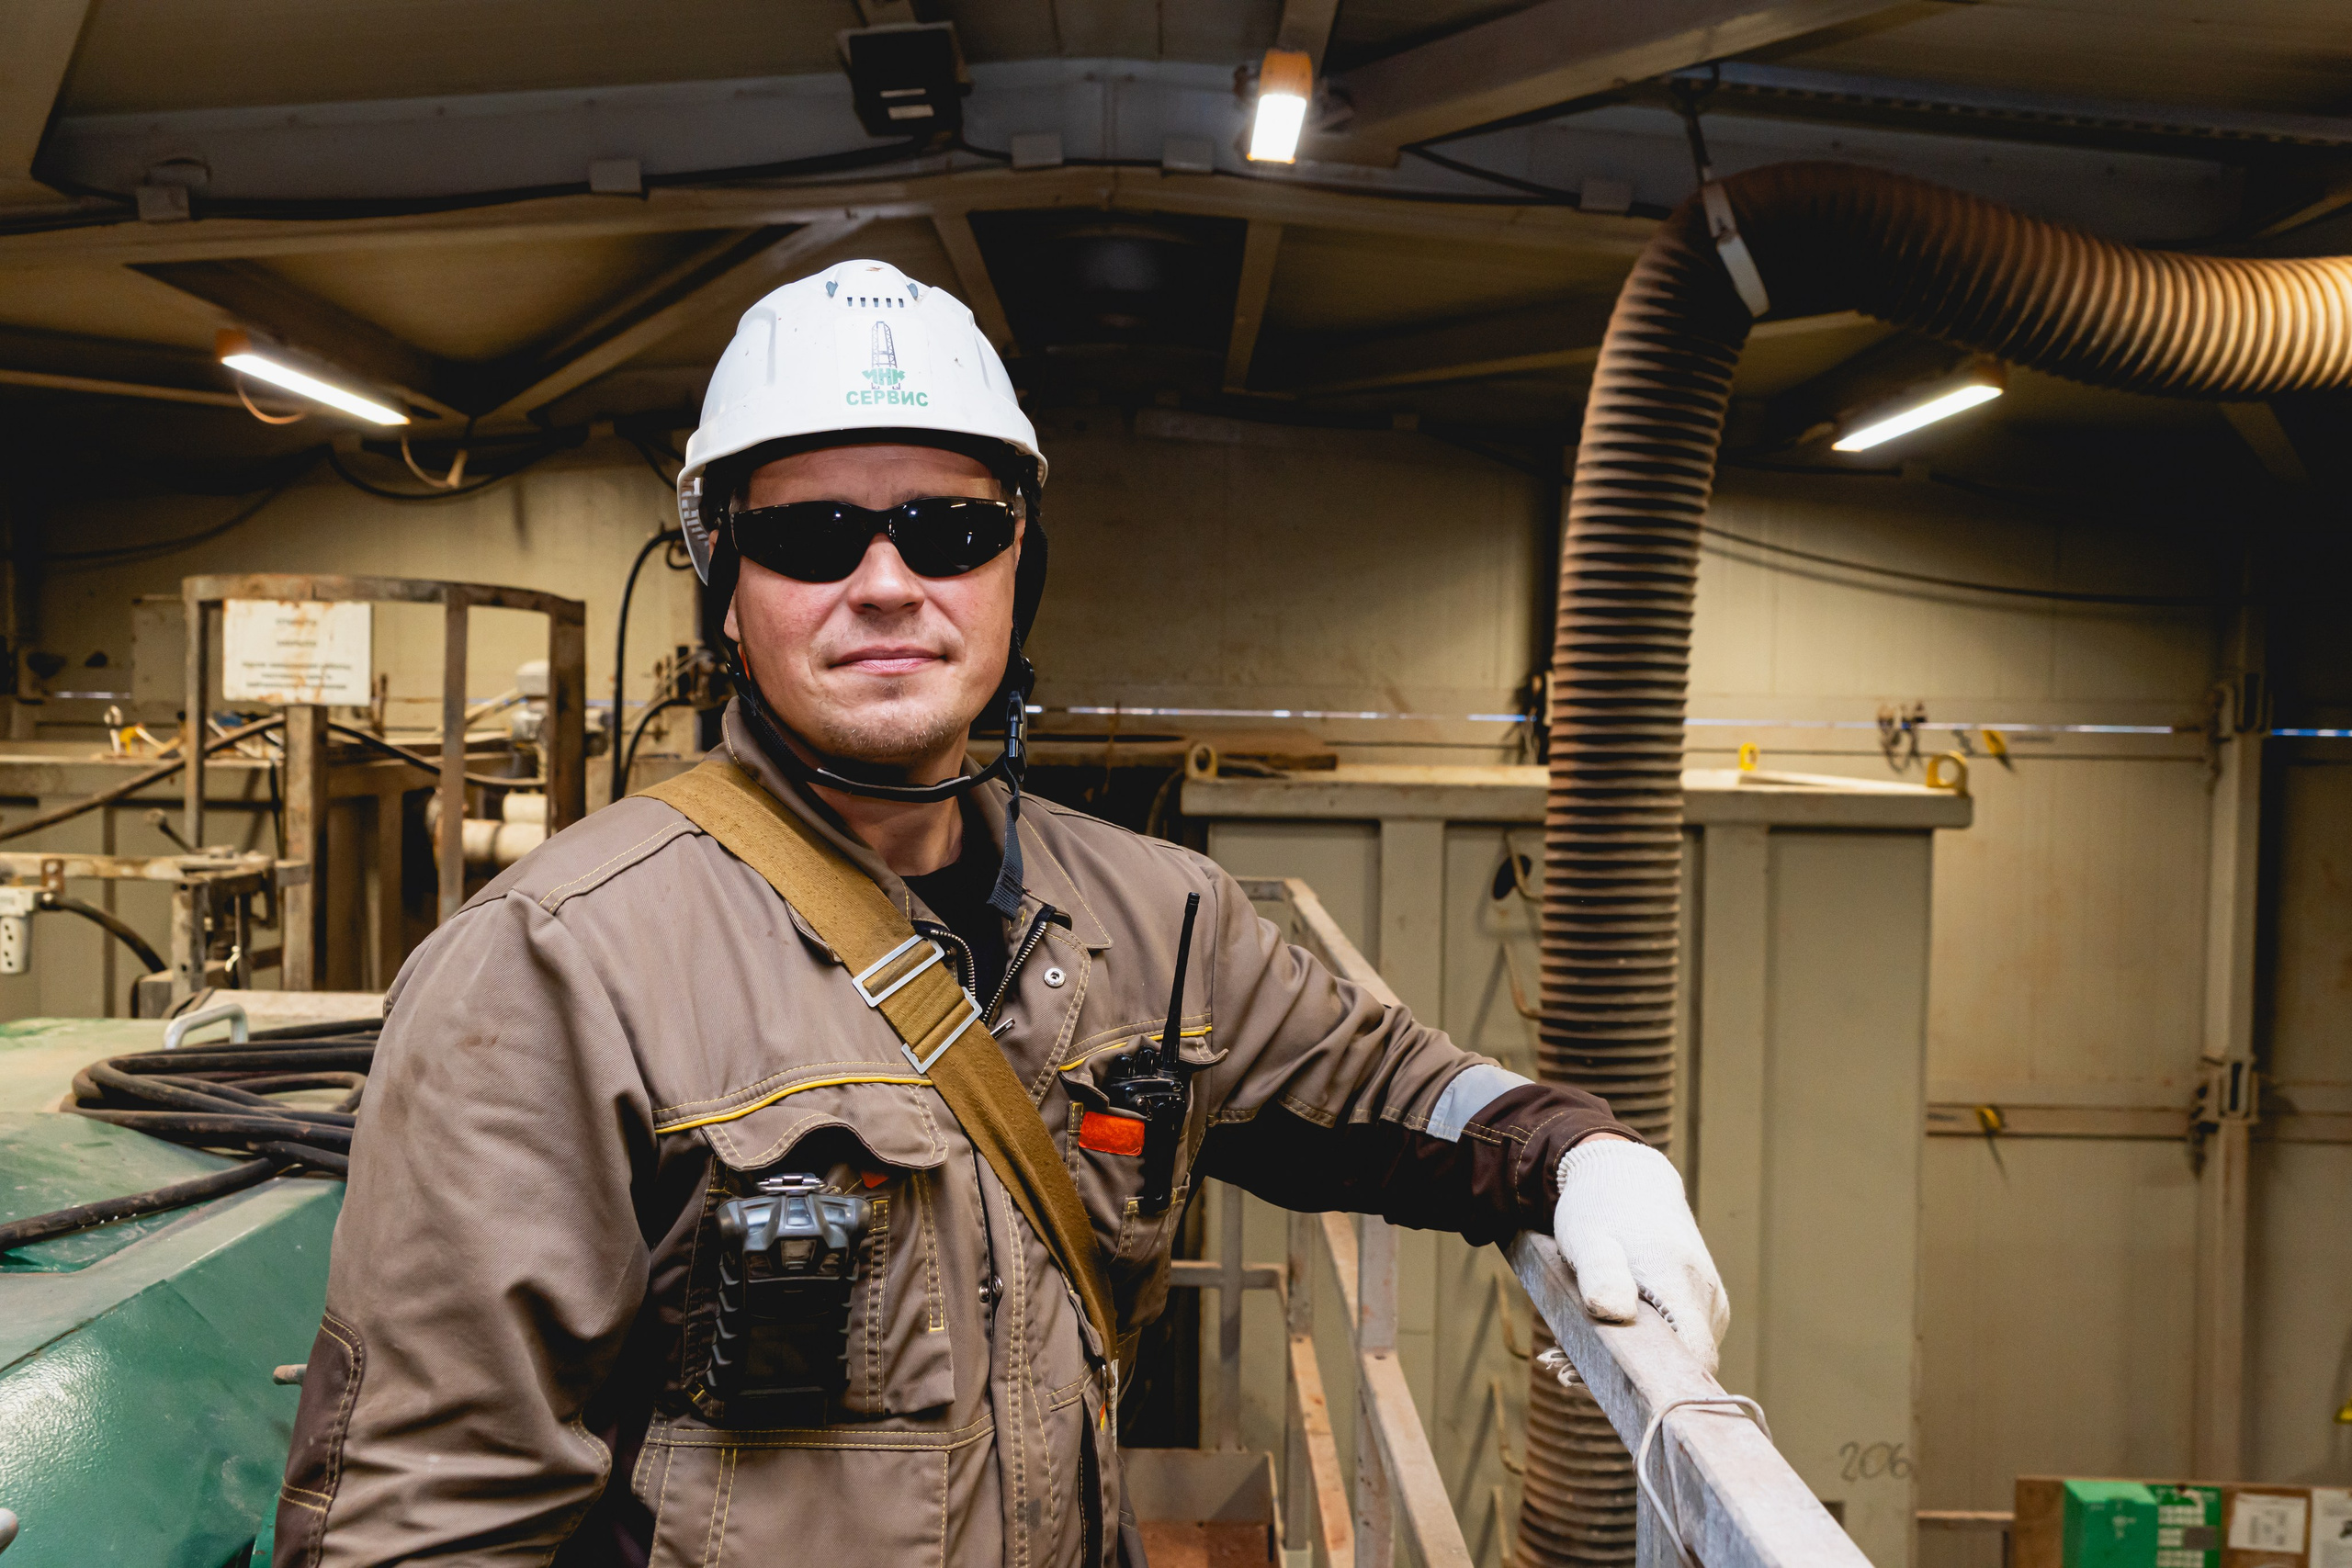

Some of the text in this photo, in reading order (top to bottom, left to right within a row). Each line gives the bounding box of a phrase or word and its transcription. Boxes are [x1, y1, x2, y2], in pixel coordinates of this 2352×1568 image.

[861, 367, 906, 386] ИНК
[846, 389, 929, 407] СЕРВИС
[1838, 1440, 1913, 1483] 206
